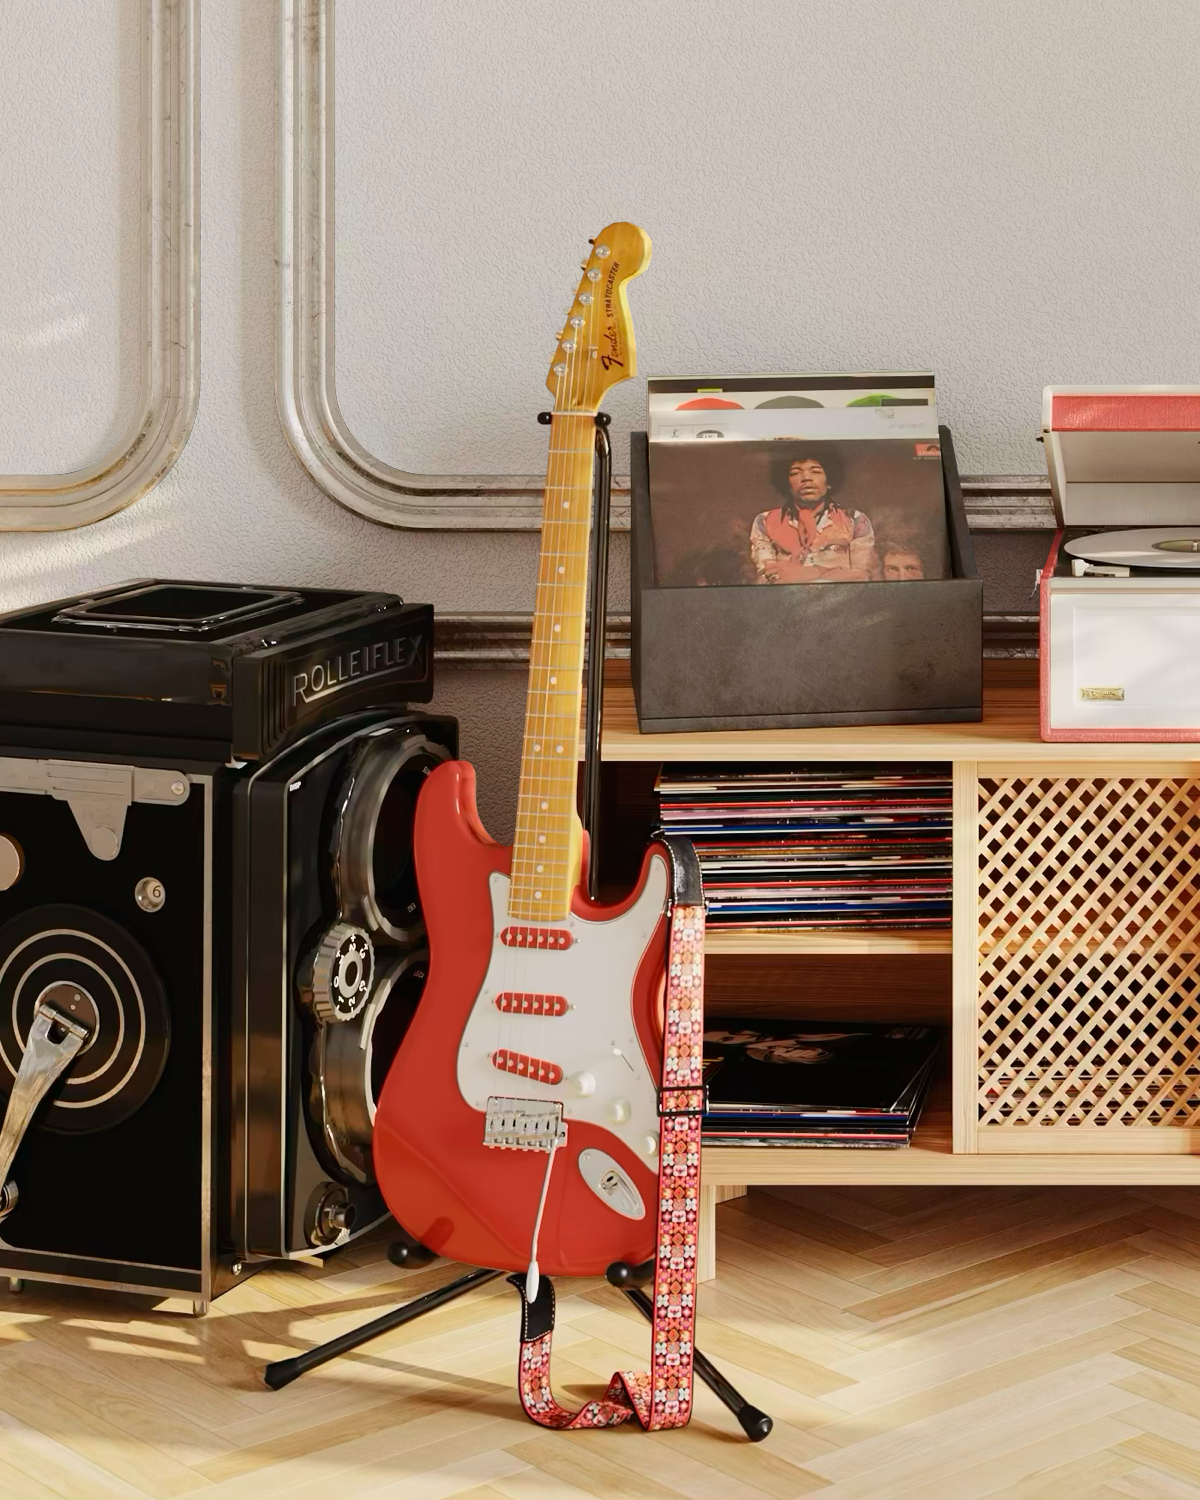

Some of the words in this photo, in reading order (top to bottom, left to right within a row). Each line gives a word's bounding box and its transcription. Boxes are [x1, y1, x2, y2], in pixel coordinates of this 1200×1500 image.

[605, 261, 620, 318] STRATOCASTER
[601, 321, 624, 370] Fender
[293, 635, 423, 707] ROLLEIFLEX
[152, 885, 161, 898] 6
